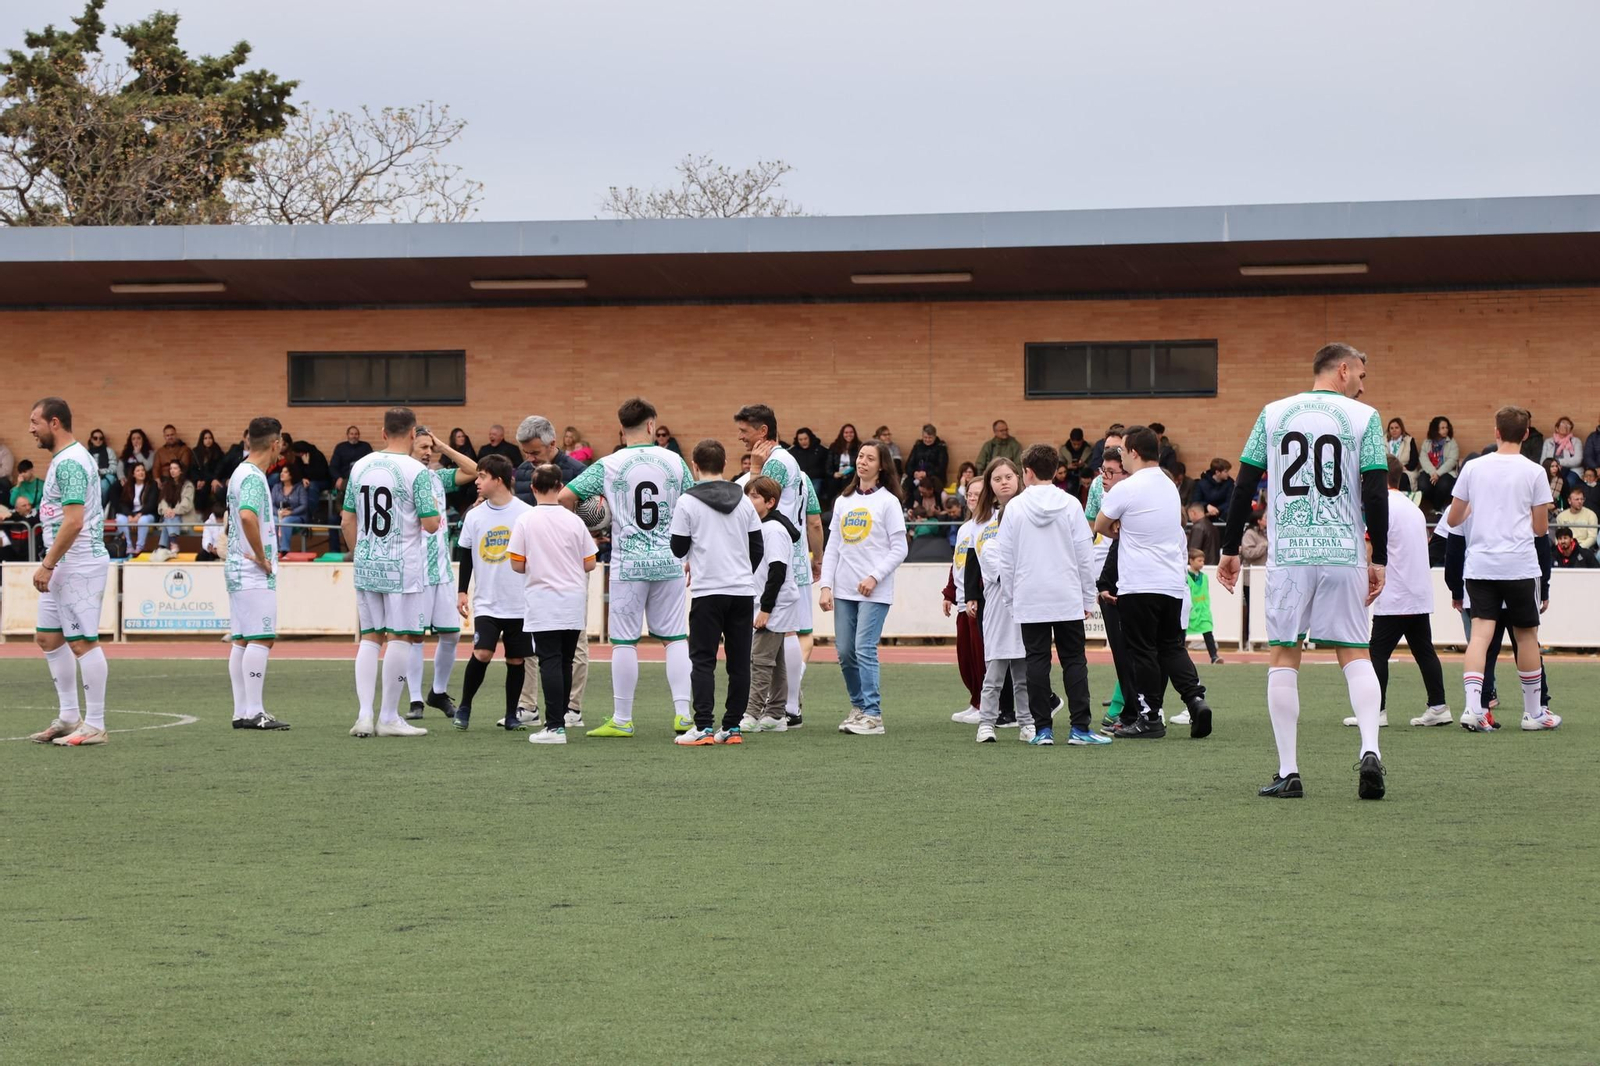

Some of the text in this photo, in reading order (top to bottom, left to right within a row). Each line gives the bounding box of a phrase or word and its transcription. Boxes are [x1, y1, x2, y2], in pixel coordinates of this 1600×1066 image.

[1281, 431, 1342, 497] 20
[360, 485, 393, 537] 18
[635, 481, 659, 530] 6
[843, 516, 867, 528] Jaén
[487, 530, 510, 538] Down
[484, 536, 510, 548] Jaén
[1289, 537, 1343, 547] PARA ESPAÑA
[159, 601, 215, 611] PALACIOS
